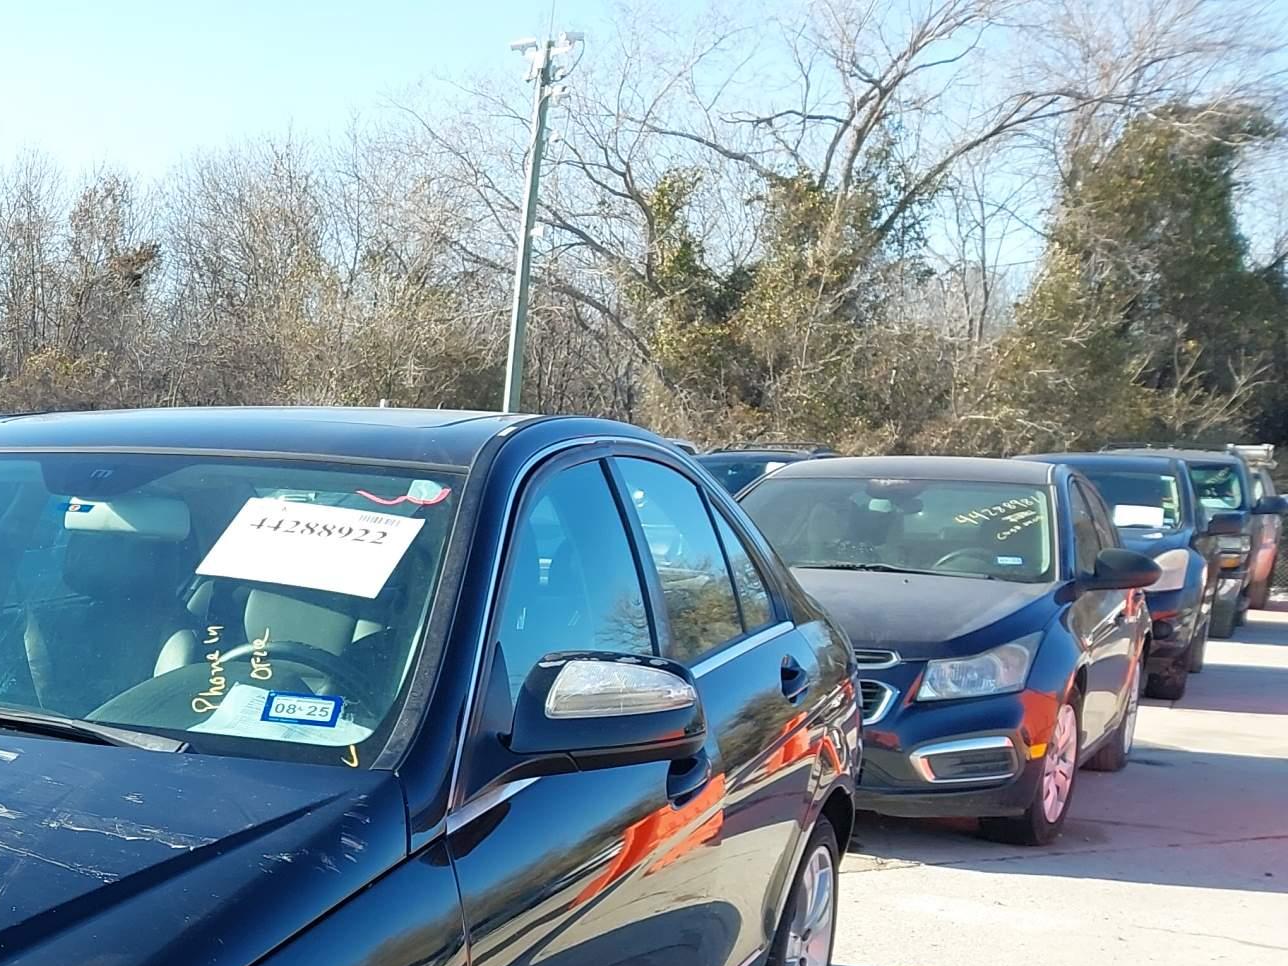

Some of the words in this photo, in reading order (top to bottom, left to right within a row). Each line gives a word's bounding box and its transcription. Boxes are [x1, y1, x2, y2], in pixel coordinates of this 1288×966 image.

[249, 516, 388, 545] 44288922
[274, 702, 297, 715] 08
[305, 704, 331, 718] 25
